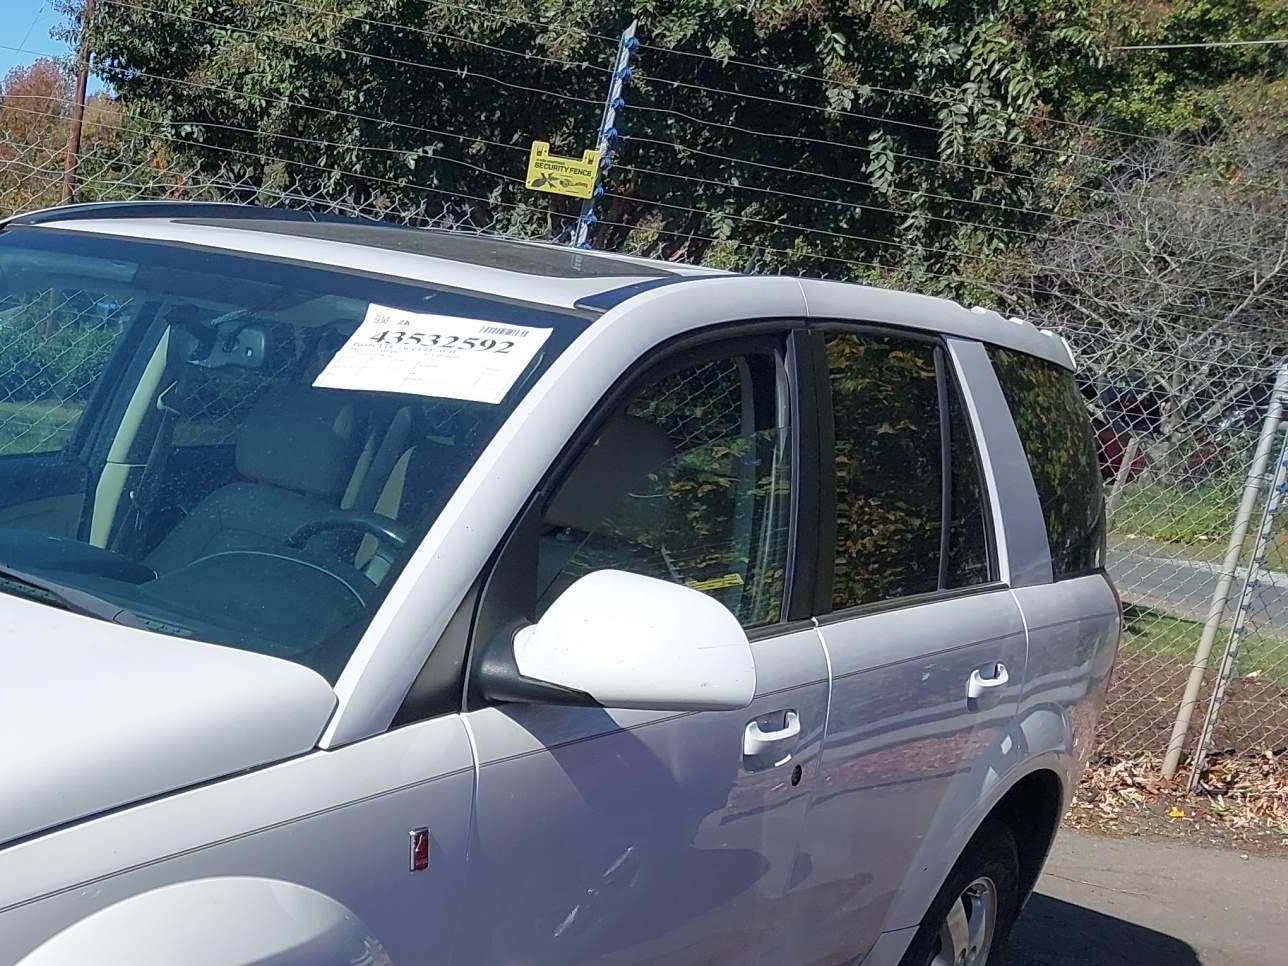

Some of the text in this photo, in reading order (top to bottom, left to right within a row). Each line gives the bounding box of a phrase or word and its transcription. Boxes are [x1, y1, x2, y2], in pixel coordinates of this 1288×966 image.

[534, 161, 570, 173] SECURITY
[569, 167, 592, 177] FENCE
[368, 329, 516, 355] 43532592
